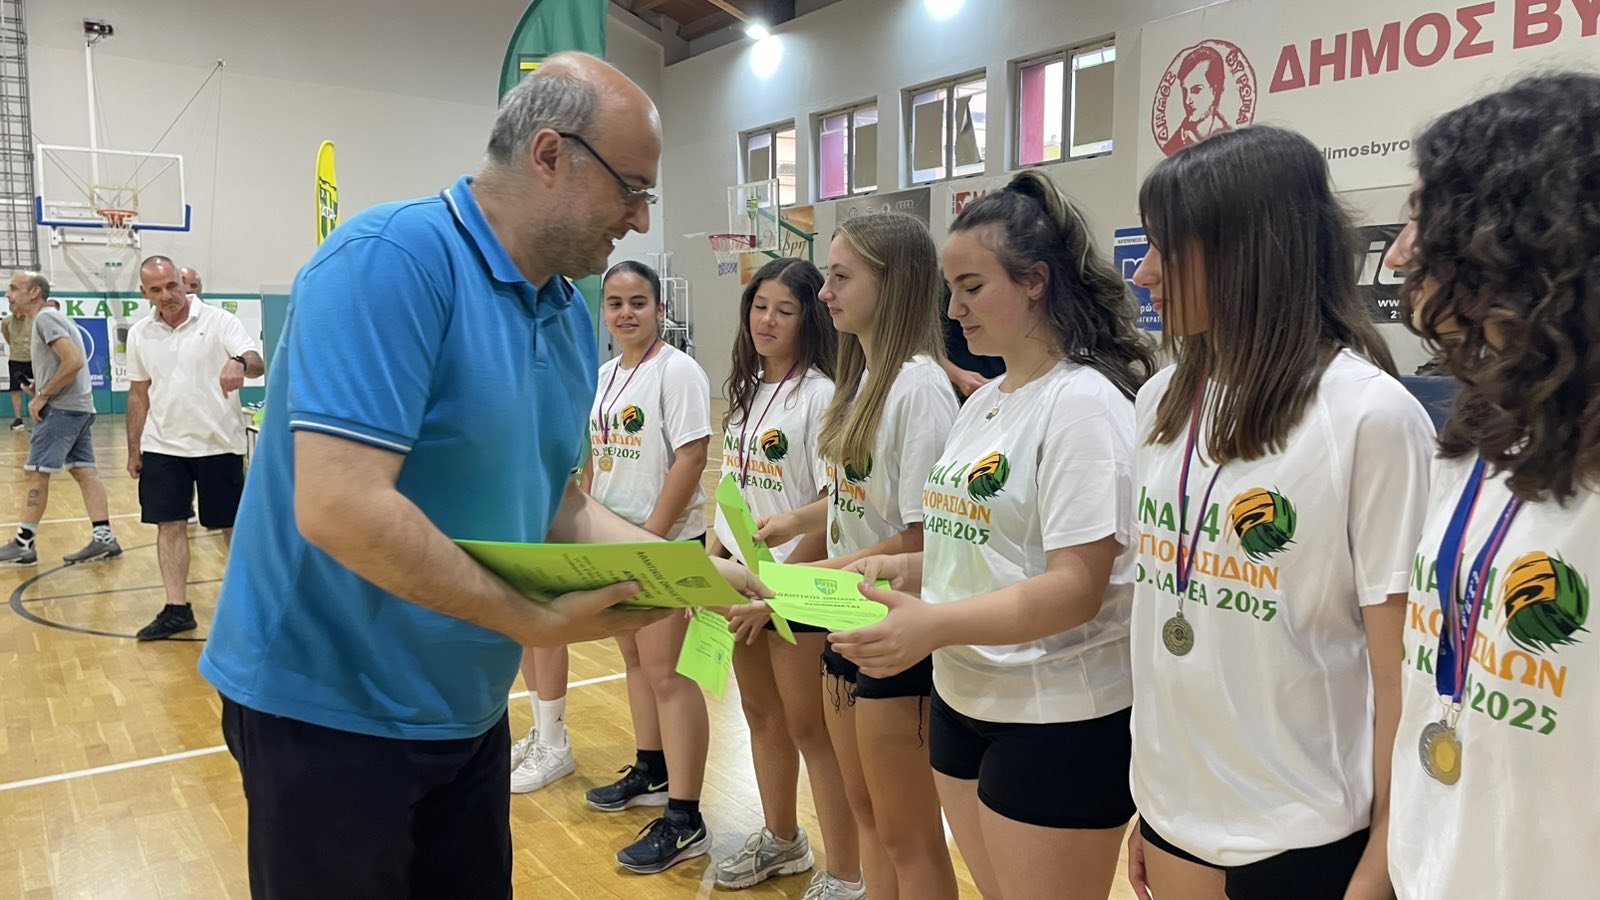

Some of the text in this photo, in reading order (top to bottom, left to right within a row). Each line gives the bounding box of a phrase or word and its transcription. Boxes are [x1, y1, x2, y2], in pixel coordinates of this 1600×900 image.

[1269, 0, 1600, 93] ΔΗΜΟΣ ΒΥ
[65, 300, 139, 317] ΚΑΡ
[1137, 315, 1162, 323] ΑΓΚΡΑΤ
[950, 462, 972, 489] 4
[840, 497, 865, 520] 205
[953, 522, 991, 545] 205
[1200, 502, 1221, 543] 4
[1216, 587, 1278, 622] 2025
[1470, 681, 1558, 736] 2025
